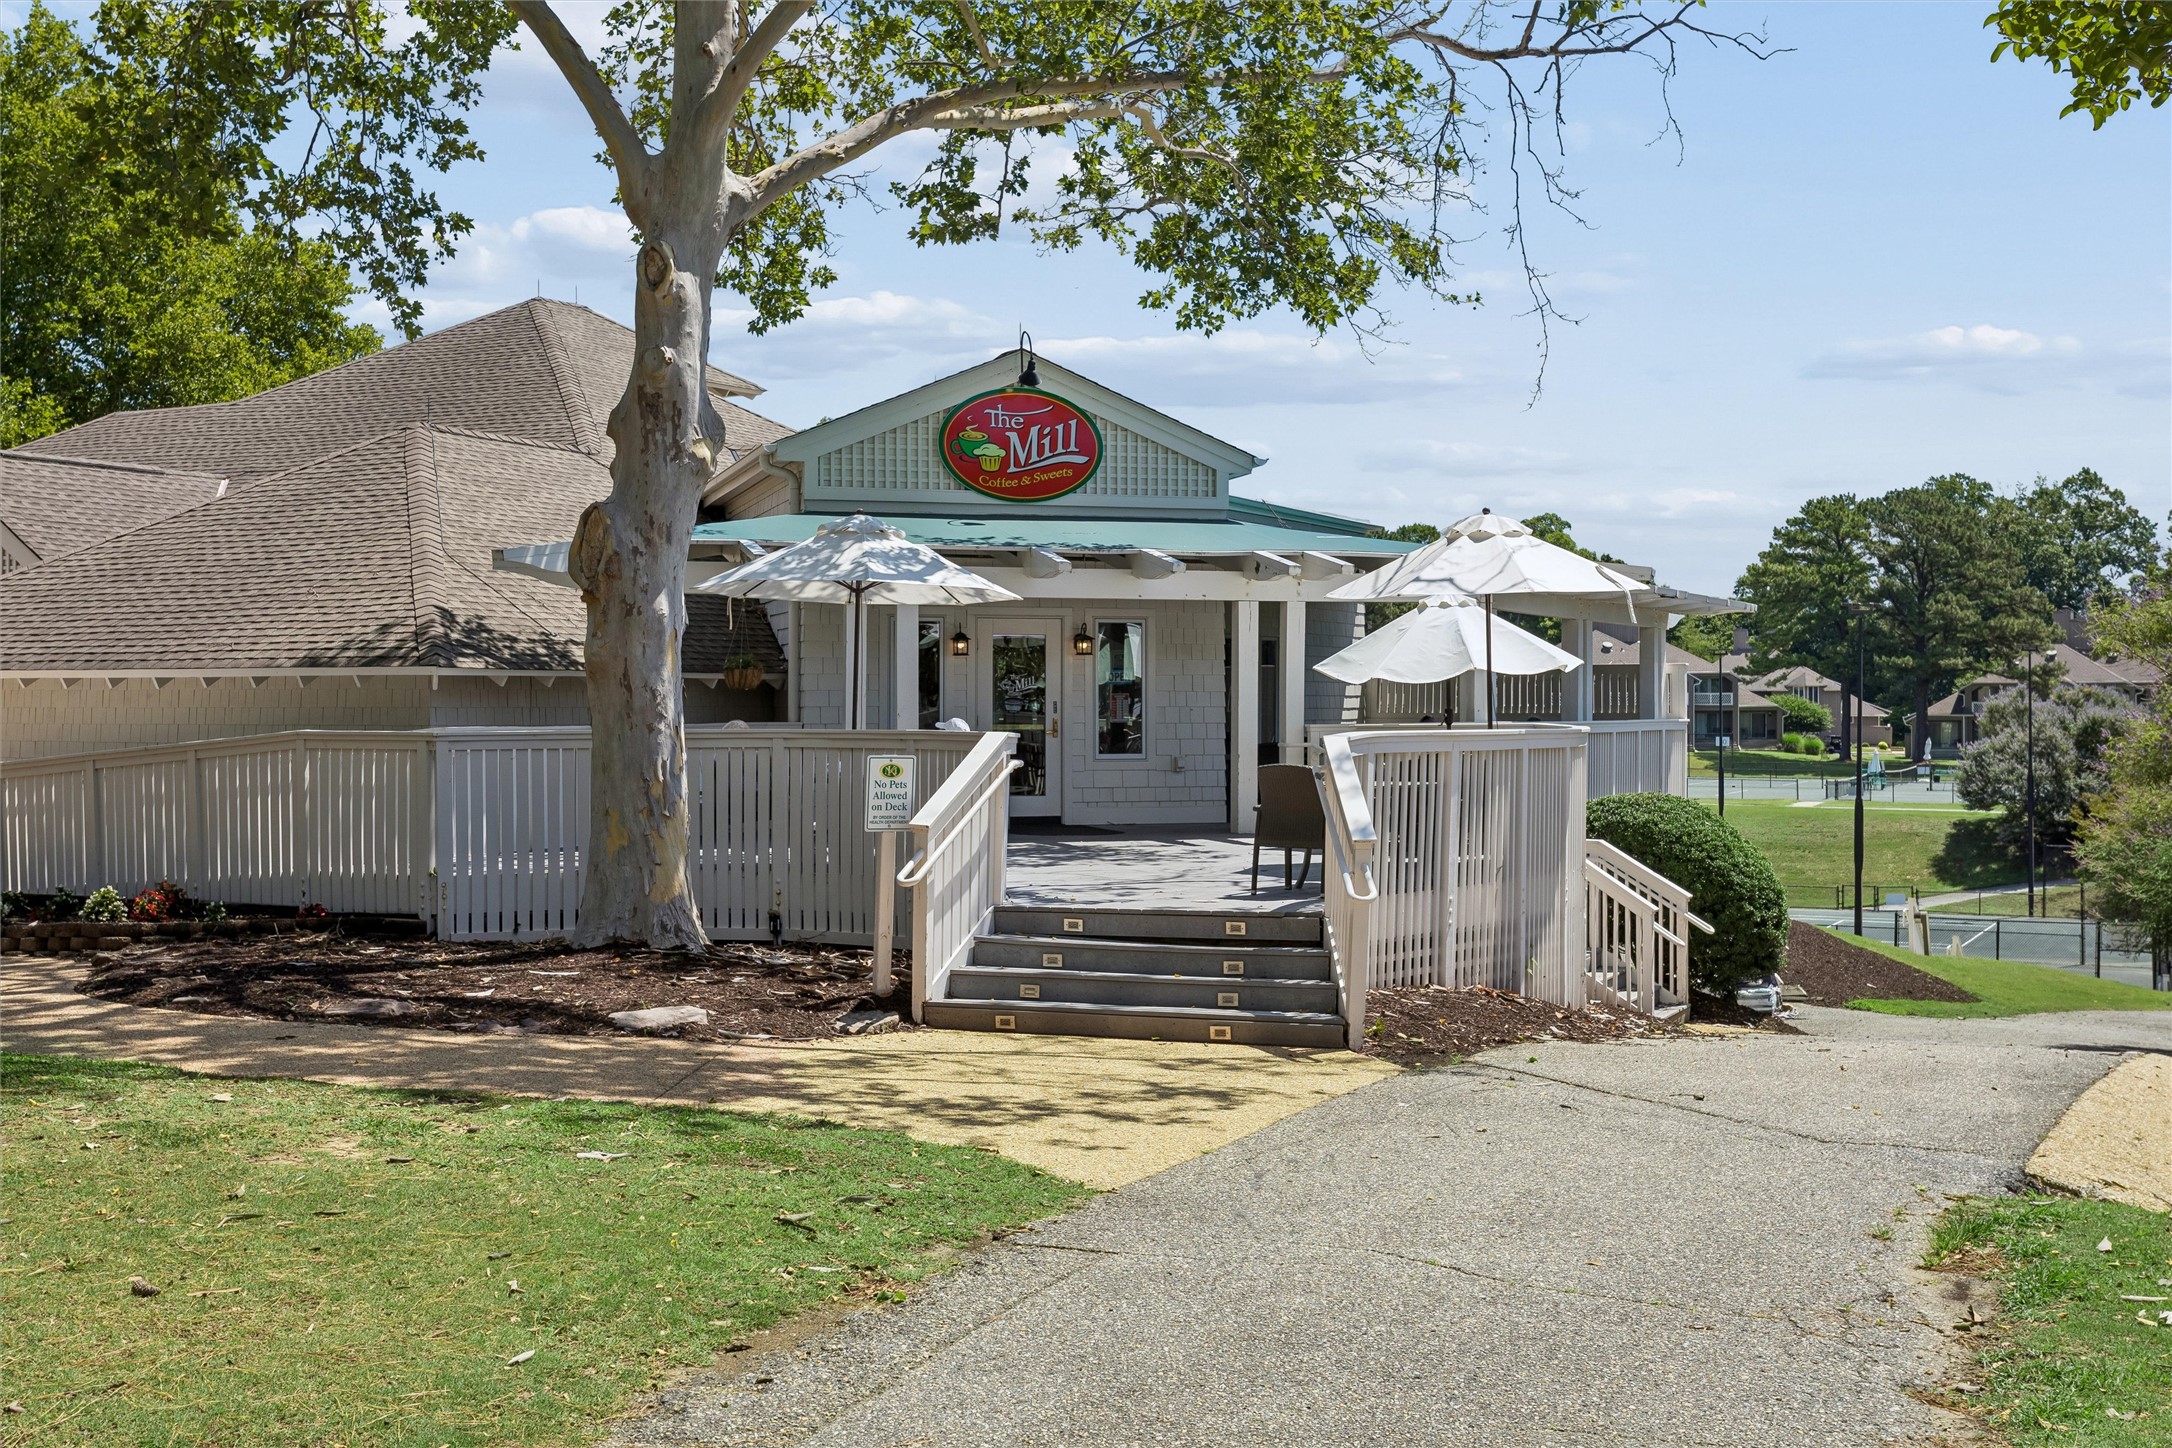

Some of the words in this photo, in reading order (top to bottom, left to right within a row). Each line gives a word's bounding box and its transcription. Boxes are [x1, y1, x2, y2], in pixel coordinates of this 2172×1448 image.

[984, 404, 1051, 429] The
[1005, 418, 1088, 474] Mill
[978, 475, 1018, 488] Coffee
[1020, 476, 1031, 485] &
[1033, 468, 1073, 483] Sweets
[1015, 675, 1036, 692] Mill
[874, 780, 887, 789] No
[889, 780, 908, 789] Pets
[872, 791, 908, 800] Allowed
[885, 802, 908, 811] Deck
